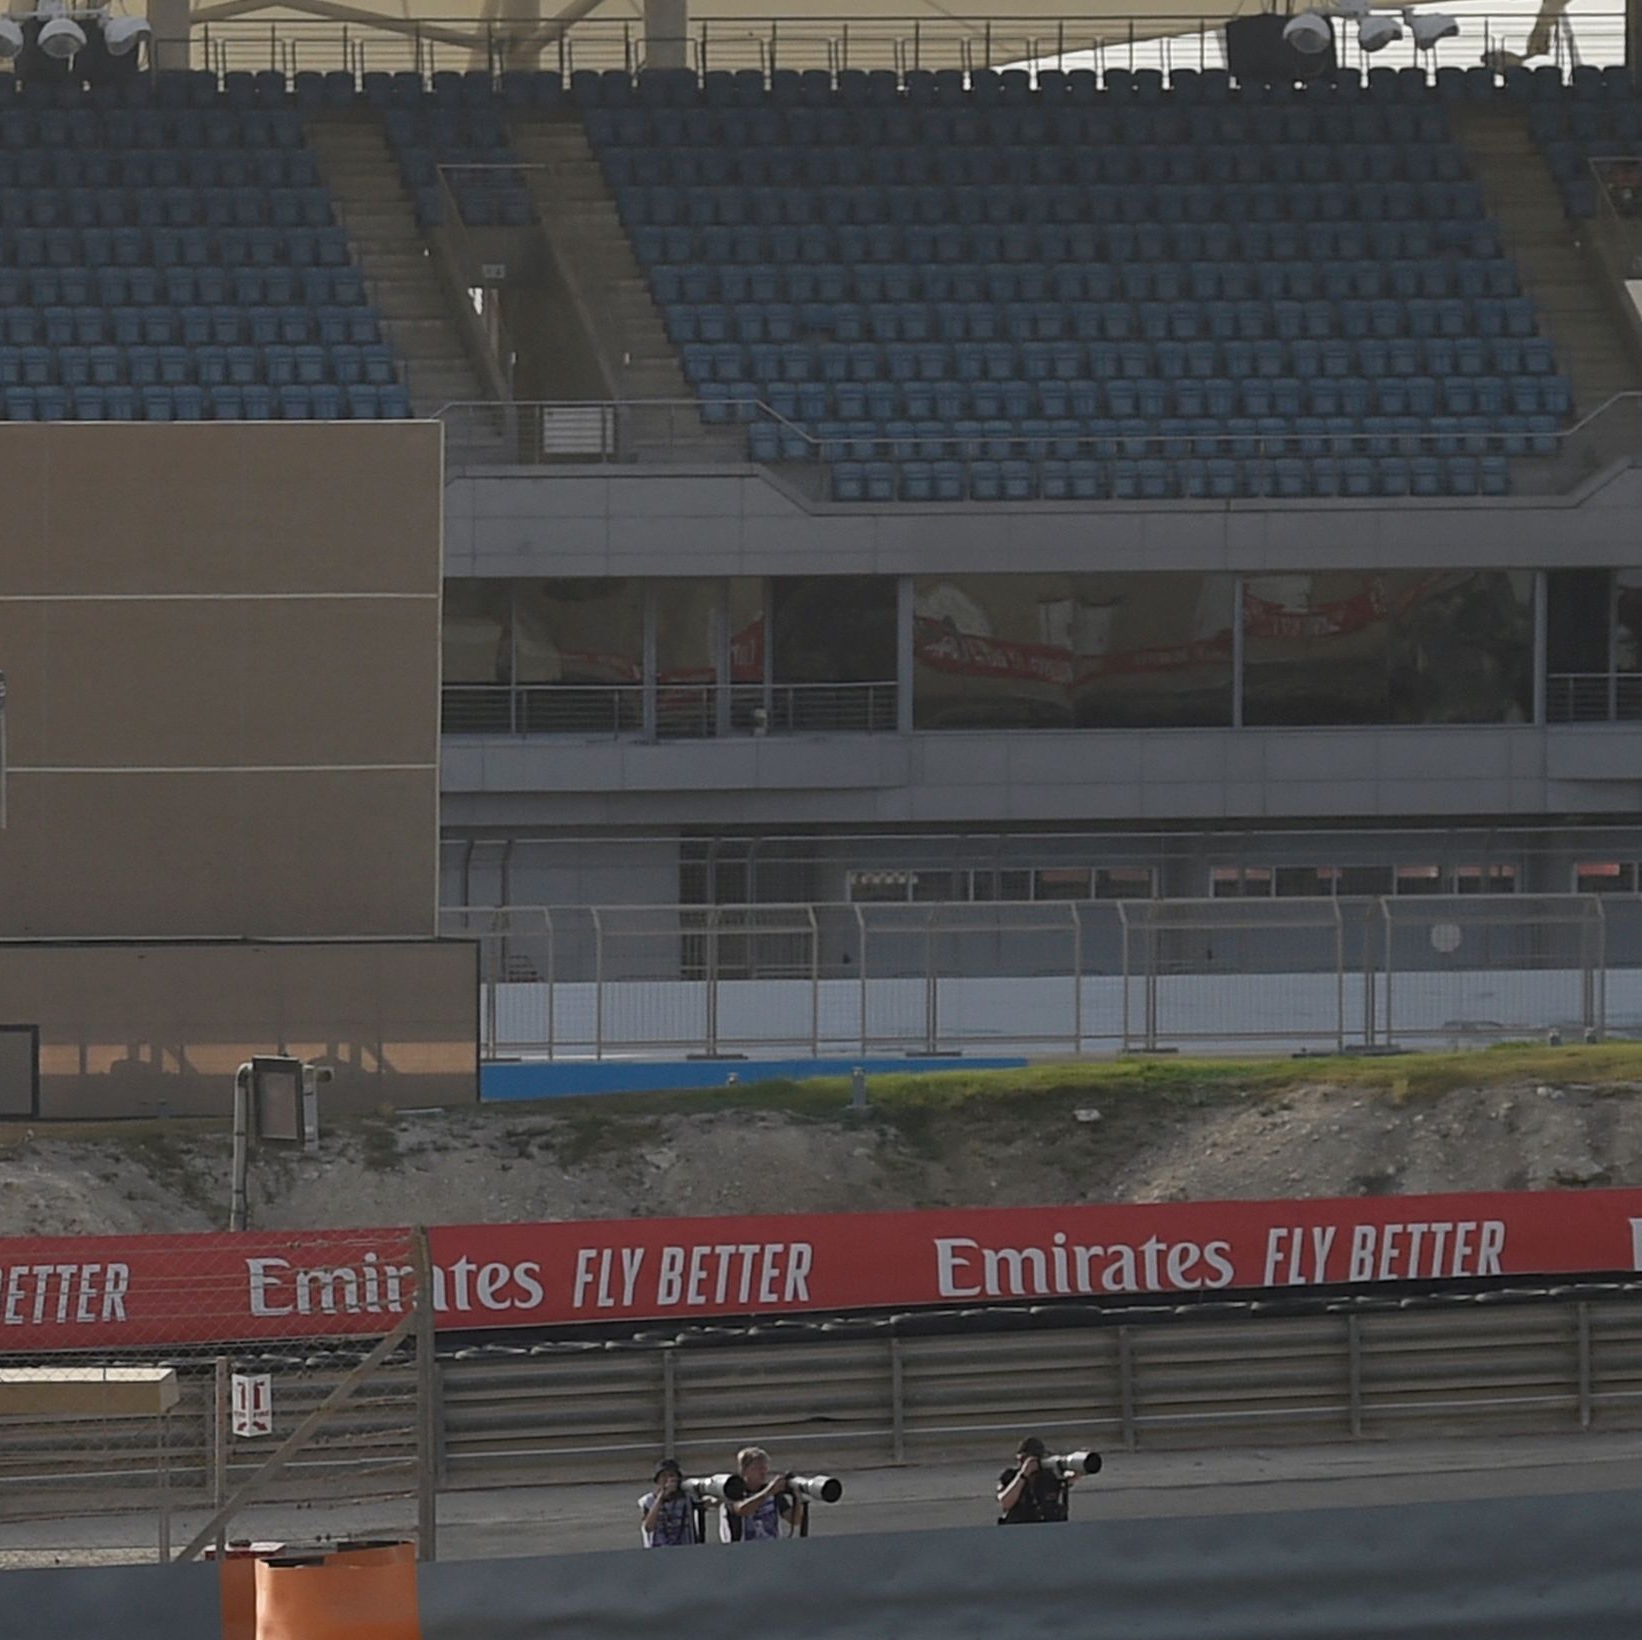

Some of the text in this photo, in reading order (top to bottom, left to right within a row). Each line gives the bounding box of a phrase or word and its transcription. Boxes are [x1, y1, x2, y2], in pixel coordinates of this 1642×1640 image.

[574, 1247, 645, 1309] FLY
[657, 1243, 813, 1305] BETTER
[933, 1220, 1506, 1297] Emirates FLY BETTER
